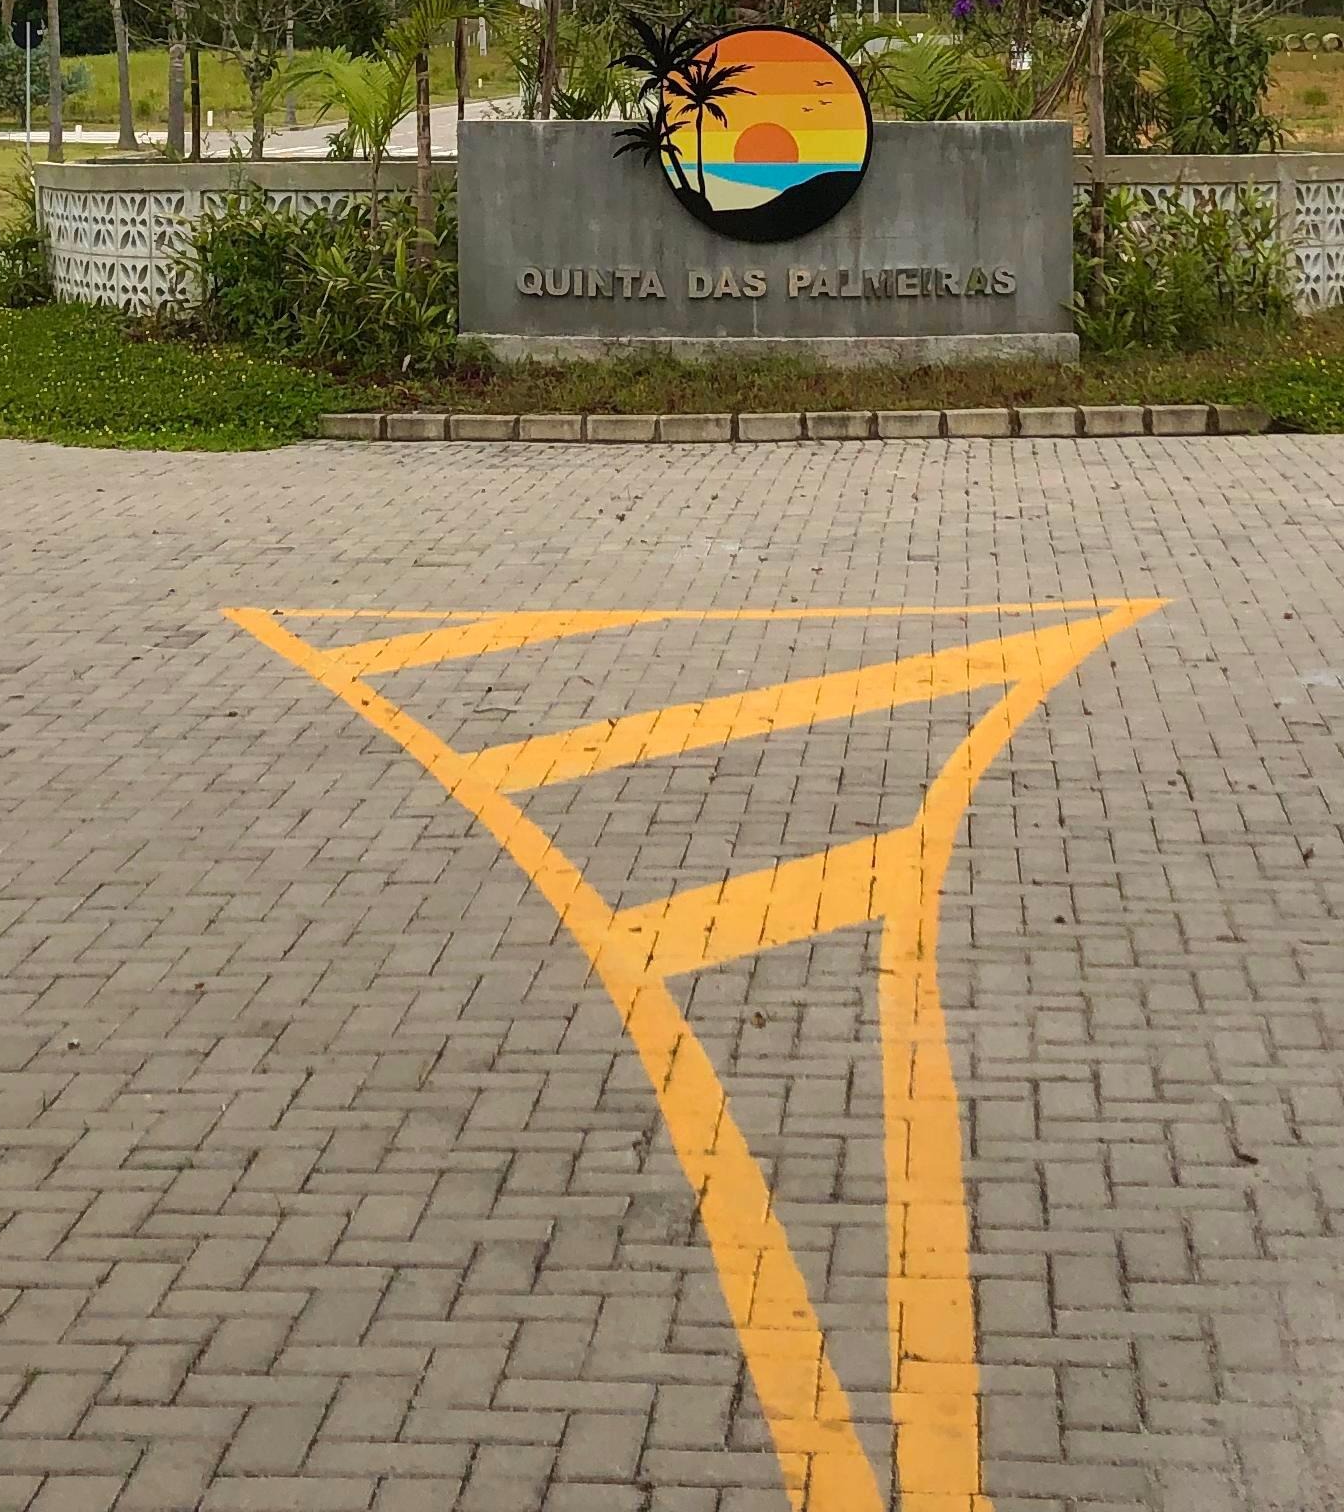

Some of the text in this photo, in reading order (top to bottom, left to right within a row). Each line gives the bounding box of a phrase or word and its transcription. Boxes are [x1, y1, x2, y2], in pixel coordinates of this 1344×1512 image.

[516, 266, 1017, 299] QUINTA DAS PALMEIRAS
